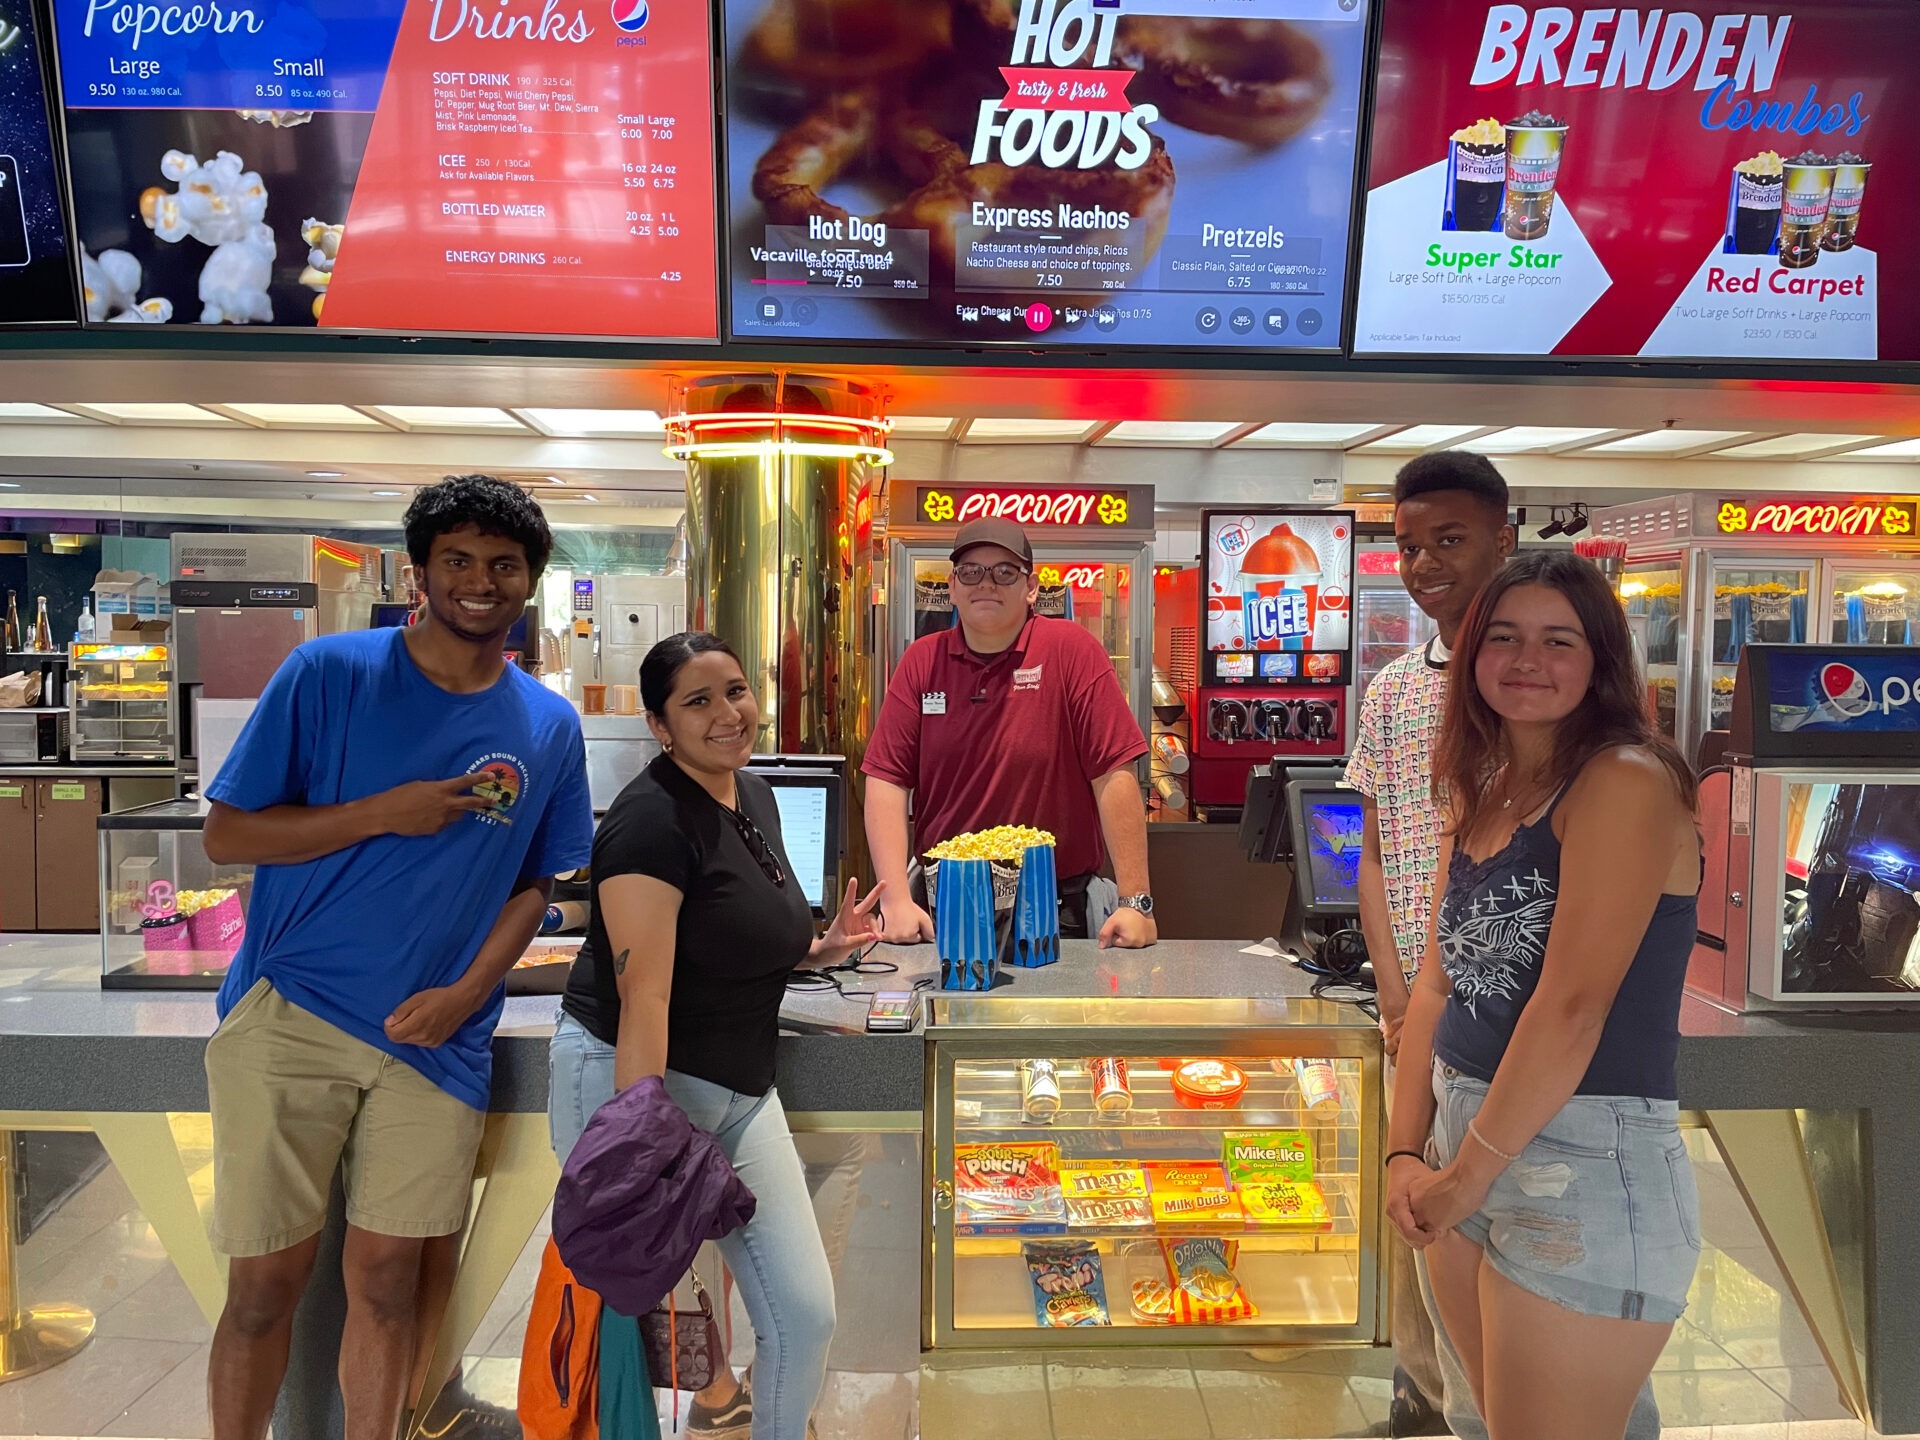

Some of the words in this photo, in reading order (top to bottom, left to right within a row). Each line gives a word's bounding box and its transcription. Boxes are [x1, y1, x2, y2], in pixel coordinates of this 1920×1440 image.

[84, 0, 265, 50] Popcorn
[429, 0, 595, 43] Drinks
[616, 36, 647, 47] pepsi
[1010, 0, 1122, 68] HOT
[1470, 3, 1793, 93] BRENDEN
[110, 57, 160, 78] Large
[273, 59, 324, 77] Small
[433, 72, 466, 85] SOFT
[469, 73, 510, 86] DRINK
[89, 84, 116, 96] 9.50
[122, 87, 137, 96] 130
[151, 87, 166, 96] 980
[167, 87, 182, 96] Cal.
[255, 85, 283, 97] 8.50
[290, 89, 301, 98] 85
[316, 90, 332, 98] 490
[332, 90, 348, 98] Cal.
[460, 89, 476, 99] Diet
[505, 91, 523, 100] Wild
[524, 91, 550, 102] Cherry
[1017, 79, 1054, 104] tasty
[1058, 82, 1068, 96] &
[1070, 82, 1108, 104] fresh
[479, 101, 495, 112] Mug
[497, 101, 516, 110] Root
[576, 103, 599, 112] Sierra
[1700, 78, 1870, 136] Combos
[457, 111, 475, 121] Pink
[618, 114, 644, 124] Small
[648, 115, 675, 128] Large
[437, 122, 456, 131] Brisk
[458, 122, 498, 134] Raspberry
[500, 124, 517, 133] Iced
[621, 129, 642, 139] 6.00
[652, 129, 672, 140] 7.00
[970, 99, 1159, 170] FOODS
[439, 155, 466, 167] ICEE
[622, 163, 634, 173] 16
[651, 164, 663, 174] 24
[665, 166, 676, 174] oz
[440, 171, 454, 180] Ask
[456, 171, 468, 180] for
[469, 172, 504, 181] Available
[624, 178, 645, 188] 5.50
[654, 178, 674, 188] 6.75
[1508, 168, 1558, 183] Brenden
[442, 203, 500, 217] BOTTLED
[503, 204, 546, 218] WATER
[626, 212, 638, 222] 20
[670, 213, 676, 222] L
[972, 201, 1053, 232] Express
[1058, 203, 1130, 230] Nachos
[630, 226, 651, 236] 4.25
[658, 227, 679, 237] 5.00
[809, 215, 843, 240] Hot
[849, 216, 886, 248] Dog
[1202, 223, 1284, 248] Pretzels
[750, 247, 817, 262] Vacaville
[971, 242, 1021, 253] Restaurant
[1024, 243, 1046, 255] style
[1048, 244, 1073, 254] round
[1074, 244, 1102, 256] chips,
[1104, 244, 1128, 256] Ricos
[446, 250, 496, 264] ENERGY
[499, 252, 546, 265] DRINKS
[966, 257, 994, 268] Nacho
[996, 258, 1029, 268] Cheese
[1031, 258, 1048, 269] and
[1050, 259, 1080, 270] choice
[1082, 260, 1090, 270] of
[1092, 260, 1133, 272] toppings.
[1425, 244, 1501, 274] Super
[1508, 245, 1563, 269] Star
[1172, 261, 1202, 271] Classic
[1204, 262, 1226, 272] Plain,
[1229, 262, 1256, 272] Salted
[1258, 264, 1266, 272] or
[660, 272, 682, 282] 4.25
[834, 276, 862, 288] 7.50
[1036, 274, 1062, 286] 7.50
[1227, 277, 1250, 288] 6.75
[1389, 272, 1418, 286] Large
[1422, 272, 1444, 284] Soft
[1447, 272, 1473, 284] Drink
[1486, 273, 1515, 286] Large
[1518, 274, 1562, 287] Popcorn
[1706, 267, 1762, 294] Red
[1768, 268, 1865, 302] Carpet
[1133, 309, 1152, 318] 0.75
[1675, 306, 1698, 318] Two
[1700, 307, 1729, 320] Large
[1732, 307, 1754, 319] Soft
[1756, 308, 1788, 320] Drinks
[1799, 308, 1826, 322] Large
[957, 493, 1096, 524] POPCORN
[1750, 504, 1882, 535] POPCORN
[1247, 592, 1310, 641] ICEE
[977, 1148, 1013, 1161] SOUR
[1235, 1147, 1276, 1160] Mike
[1281, 1148, 1305, 1162] Ike
[964, 1159, 1029, 1178] PUNCH
[1263, 1189, 1297, 1199] SOUR
[1164, 1199, 1194, 1213] Milk
[1195, 1194, 1230, 1208] Duds
[1265, 1199, 1303, 1209] PATCH
